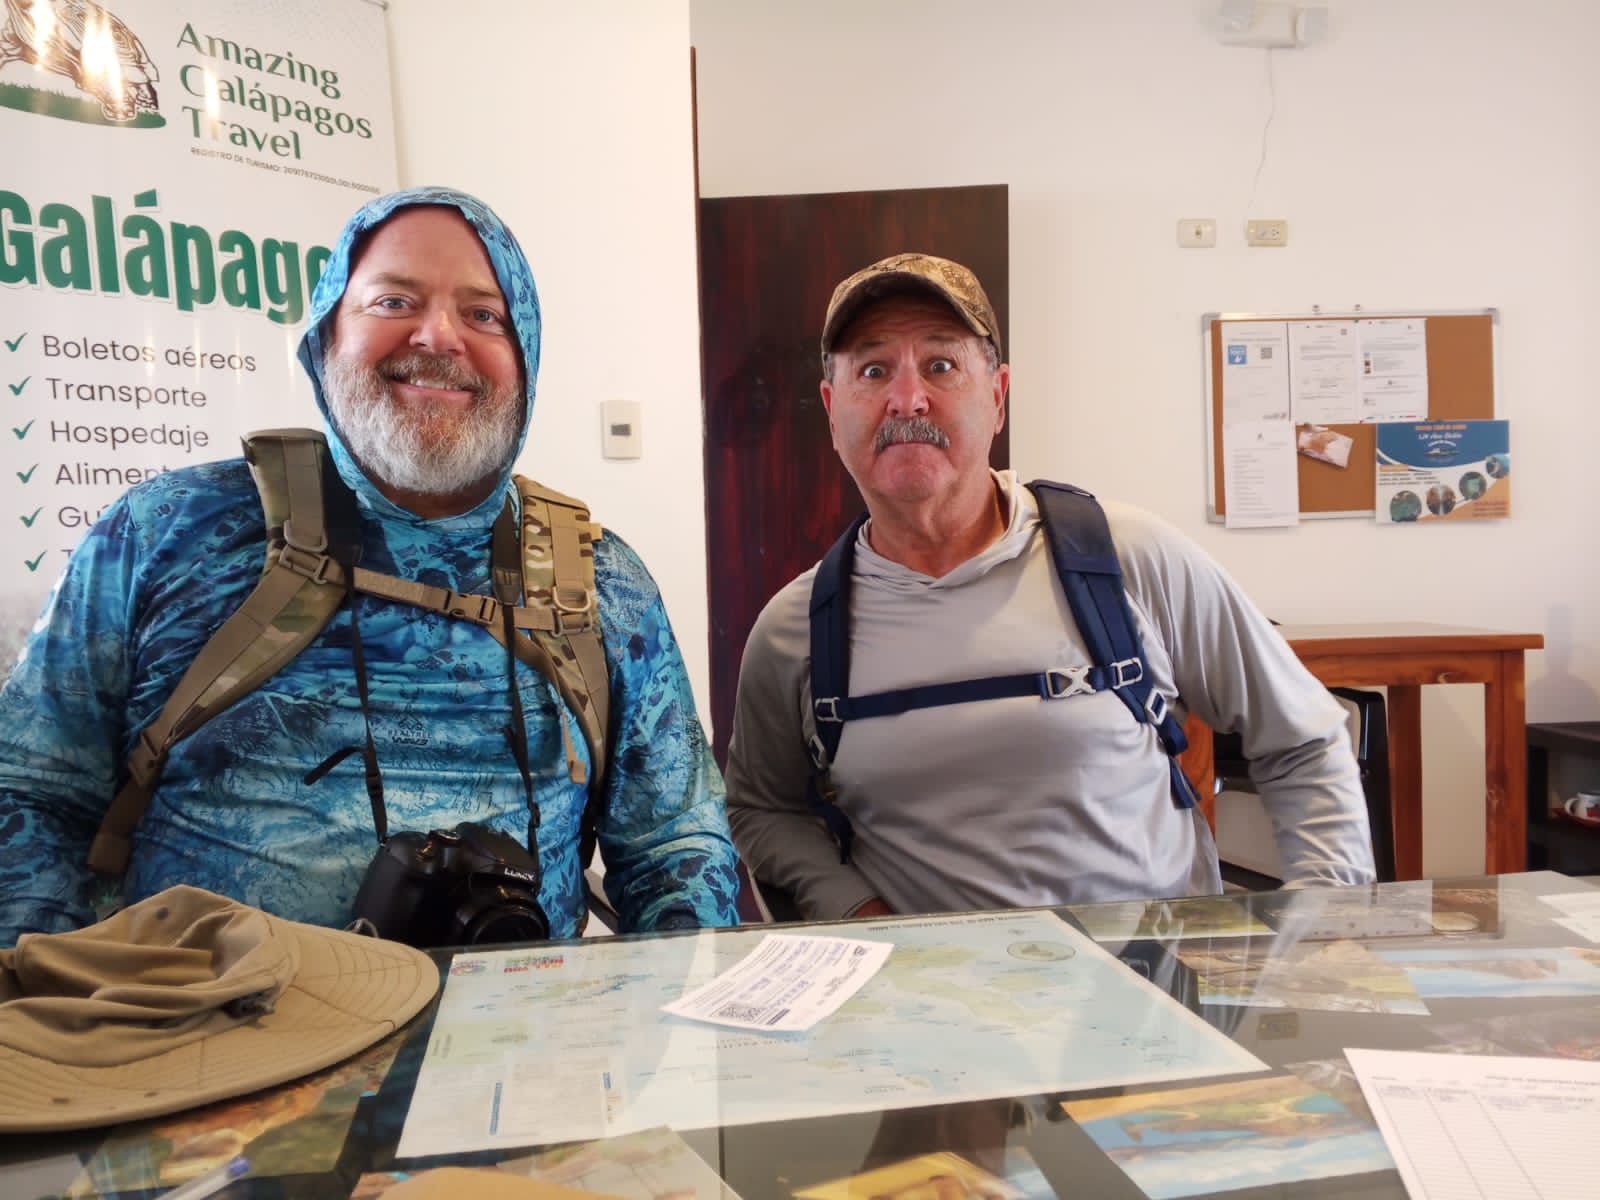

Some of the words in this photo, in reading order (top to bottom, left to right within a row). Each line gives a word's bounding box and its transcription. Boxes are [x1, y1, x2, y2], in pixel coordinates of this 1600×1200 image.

[176, 22, 341, 99] Amazing
[182, 105, 301, 160] Travel
[43, 335, 156, 364] Boletos
[165, 345, 257, 372] aéreos
[45, 377, 208, 409] Transporte
[50, 420, 209, 453] Hospedaje
[58, 504, 109, 528] Gu
